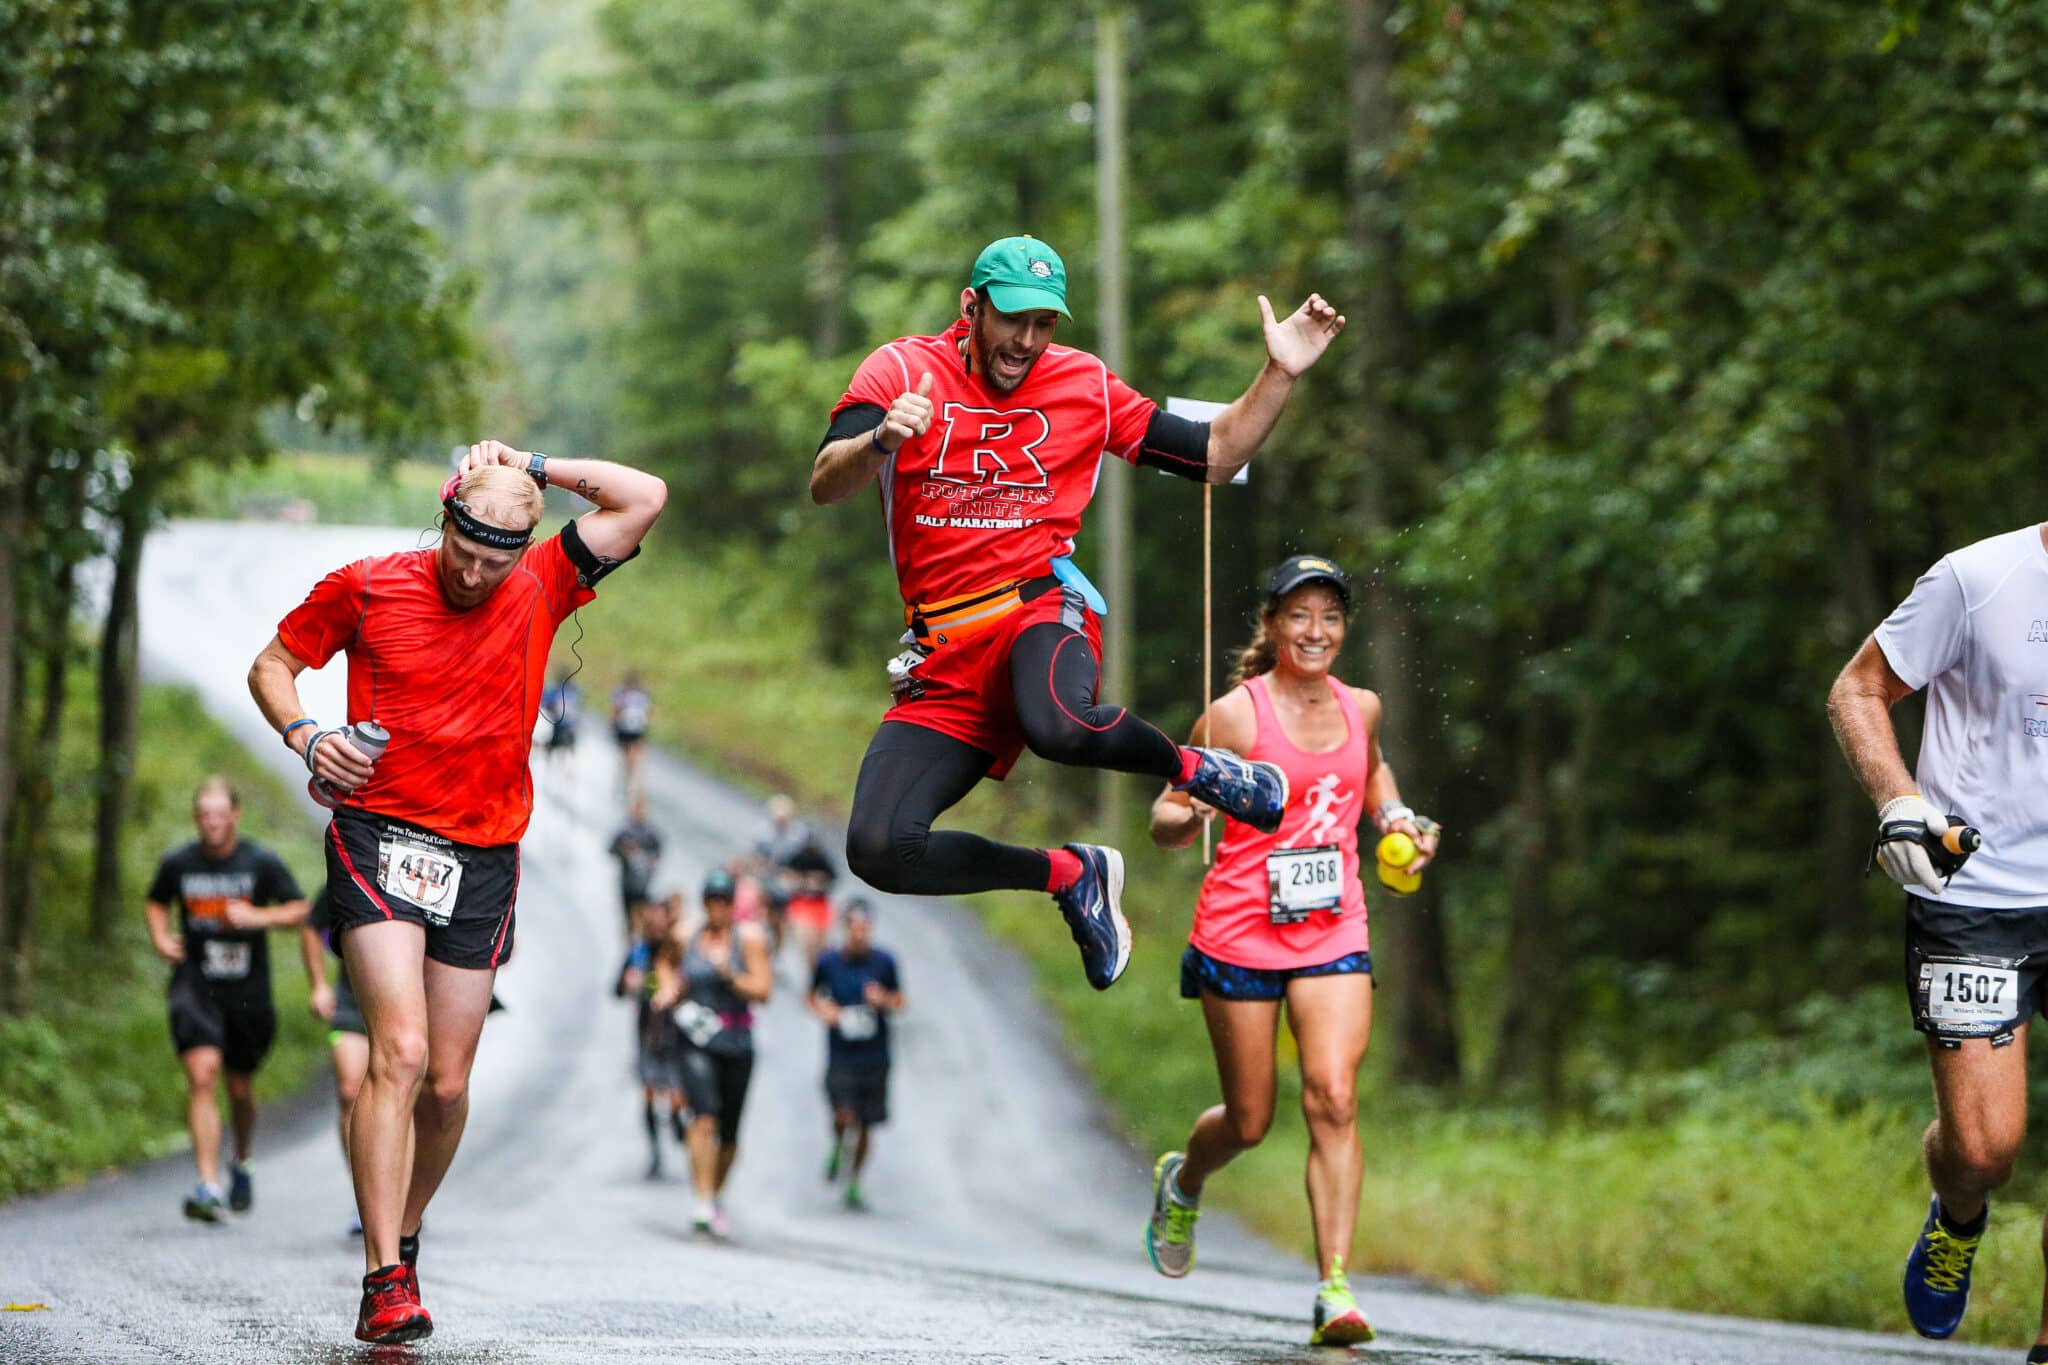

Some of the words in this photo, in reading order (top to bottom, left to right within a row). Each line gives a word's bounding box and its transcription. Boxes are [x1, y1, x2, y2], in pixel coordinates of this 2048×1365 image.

[928, 402, 1049, 487] R
[915, 514, 947, 528] HALF
[950, 517, 1023, 529] MARATHON
[948, 501, 1022, 518] UNITE
[1291, 860, 1336, 886] 2368
[1943, 972, 2007, 1004] 1507
